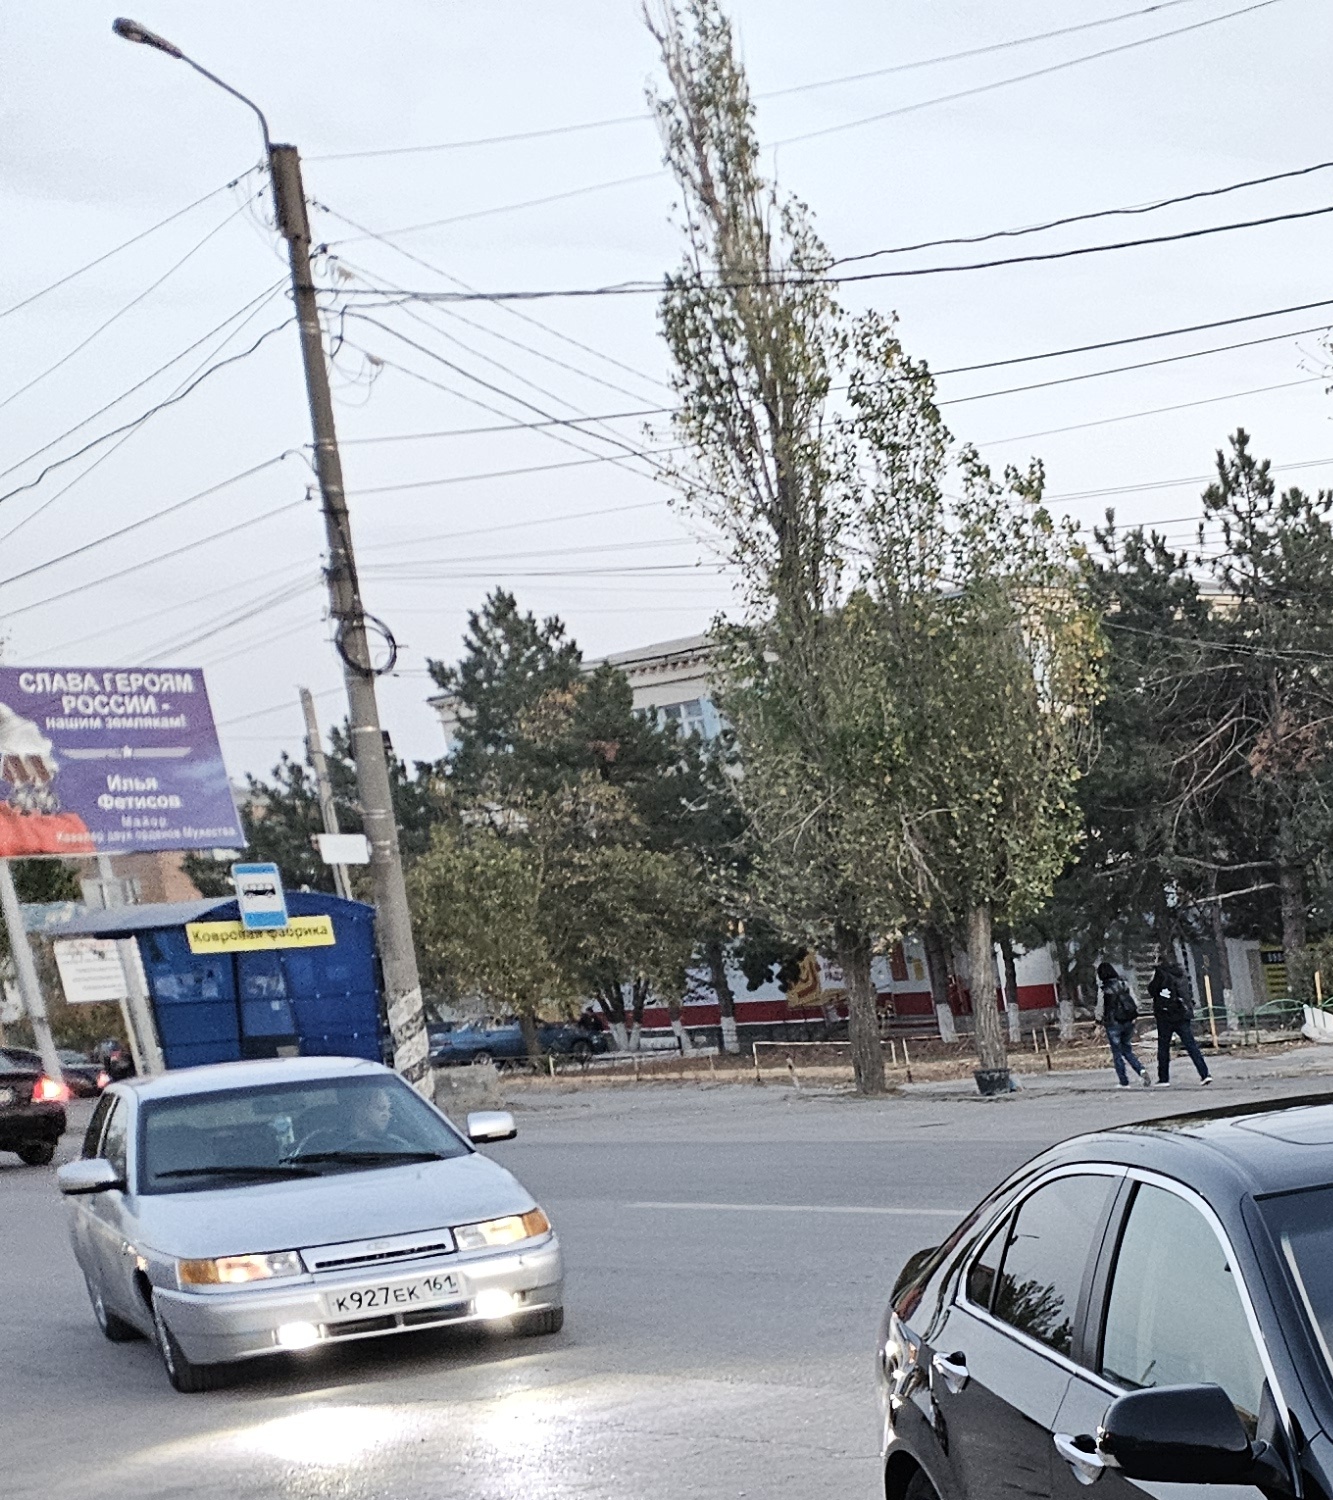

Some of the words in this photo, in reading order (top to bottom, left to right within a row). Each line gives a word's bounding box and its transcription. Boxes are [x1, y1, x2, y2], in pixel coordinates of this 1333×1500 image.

[19, 672, 99, 693] СЛАВА
[102, 672, 195, 693] ГЕРОЯМ
[61, 694, 157, 715] РОССИИ
[46, 716, 103, 730] нашим
[105, 714, 188, 730] землякам!
[107, 774, 158, 792] Илья
[97, 794, 182, 811] Фетисов
[336, 1286, 420, 1312] К927ЕК
[423, 1275, 457, 1292] 161
